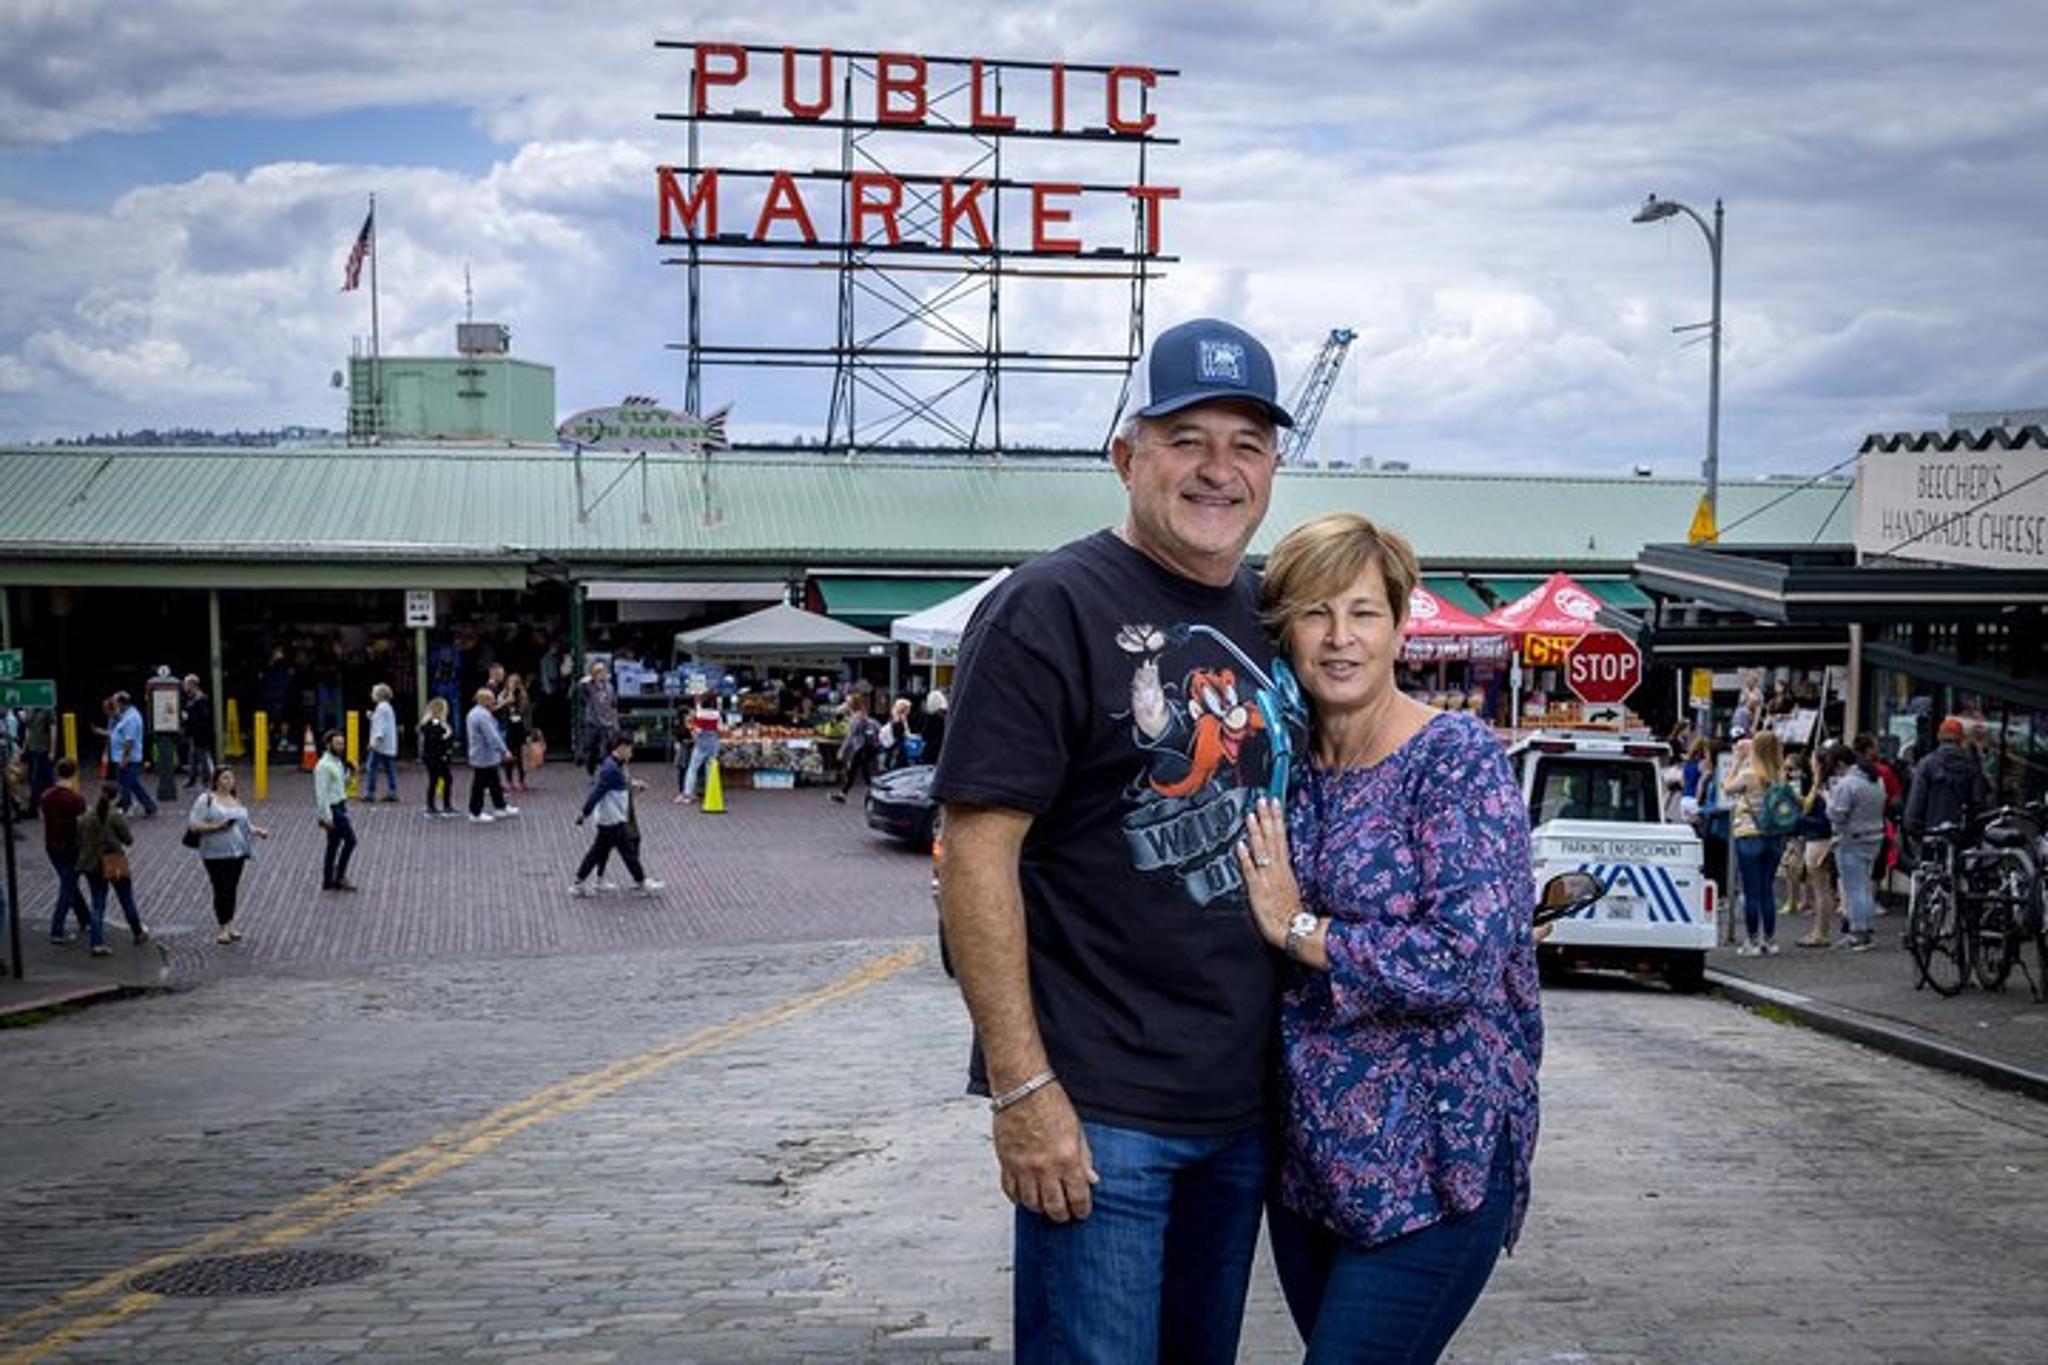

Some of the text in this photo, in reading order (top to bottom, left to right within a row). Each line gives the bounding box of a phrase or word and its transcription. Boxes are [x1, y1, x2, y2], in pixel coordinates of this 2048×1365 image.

[694, 43, 1158, 134] PUBLIC
[656, 165, 1181, 257] MARKET
[1917, 463, 2003, 500] BEECHER'S
[1882, 508, 2046, 556] HANDMADE CHEESE
[1571, 653, 1637, 683] STOP
[1561, 840, 1682, 858] PARKING ENFORCEMENT
